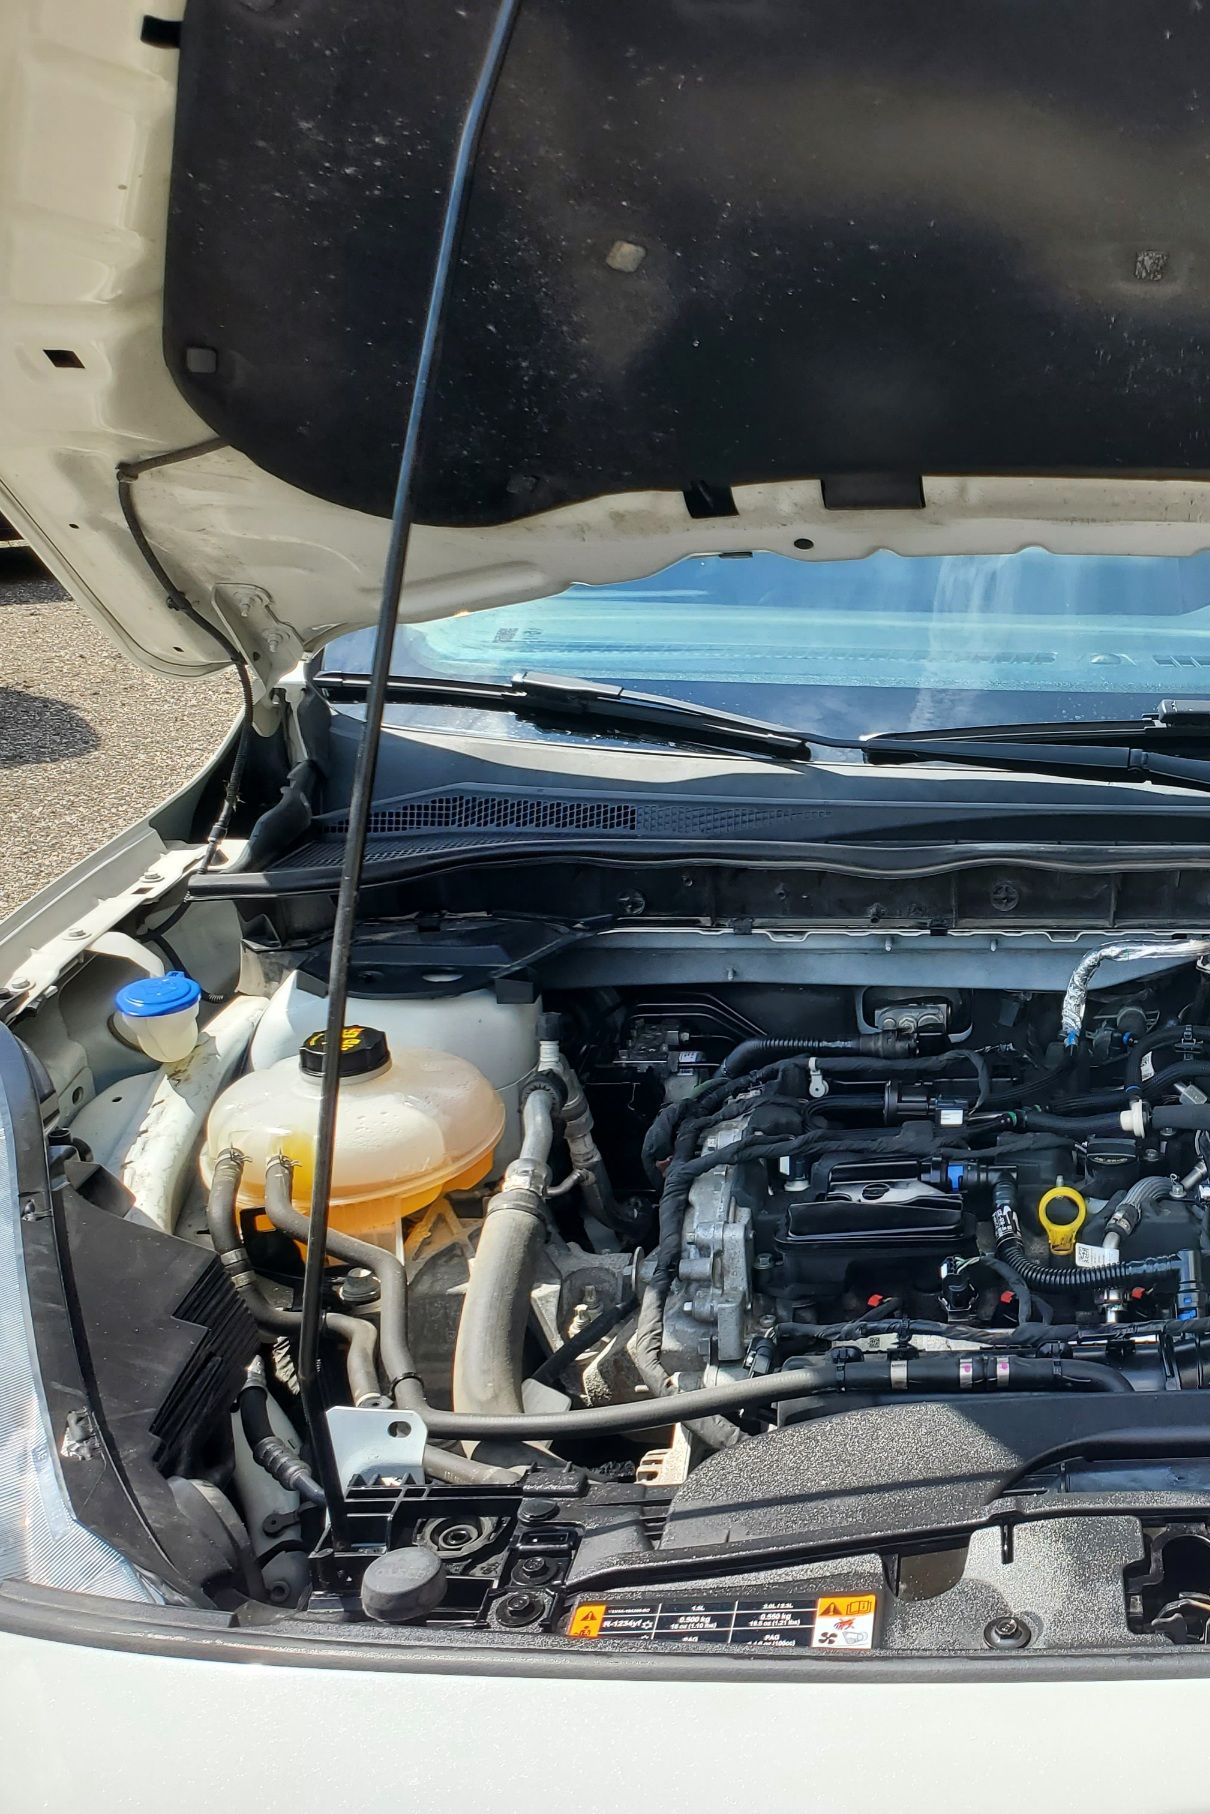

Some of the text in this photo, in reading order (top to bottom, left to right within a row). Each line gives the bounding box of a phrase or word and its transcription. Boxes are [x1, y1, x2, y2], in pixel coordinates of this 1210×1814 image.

[700, 1615, 711, 1623] kg
[781, 1612, 792, 1620] kg
[603, 1619, 642, 1627] R-1234yf
